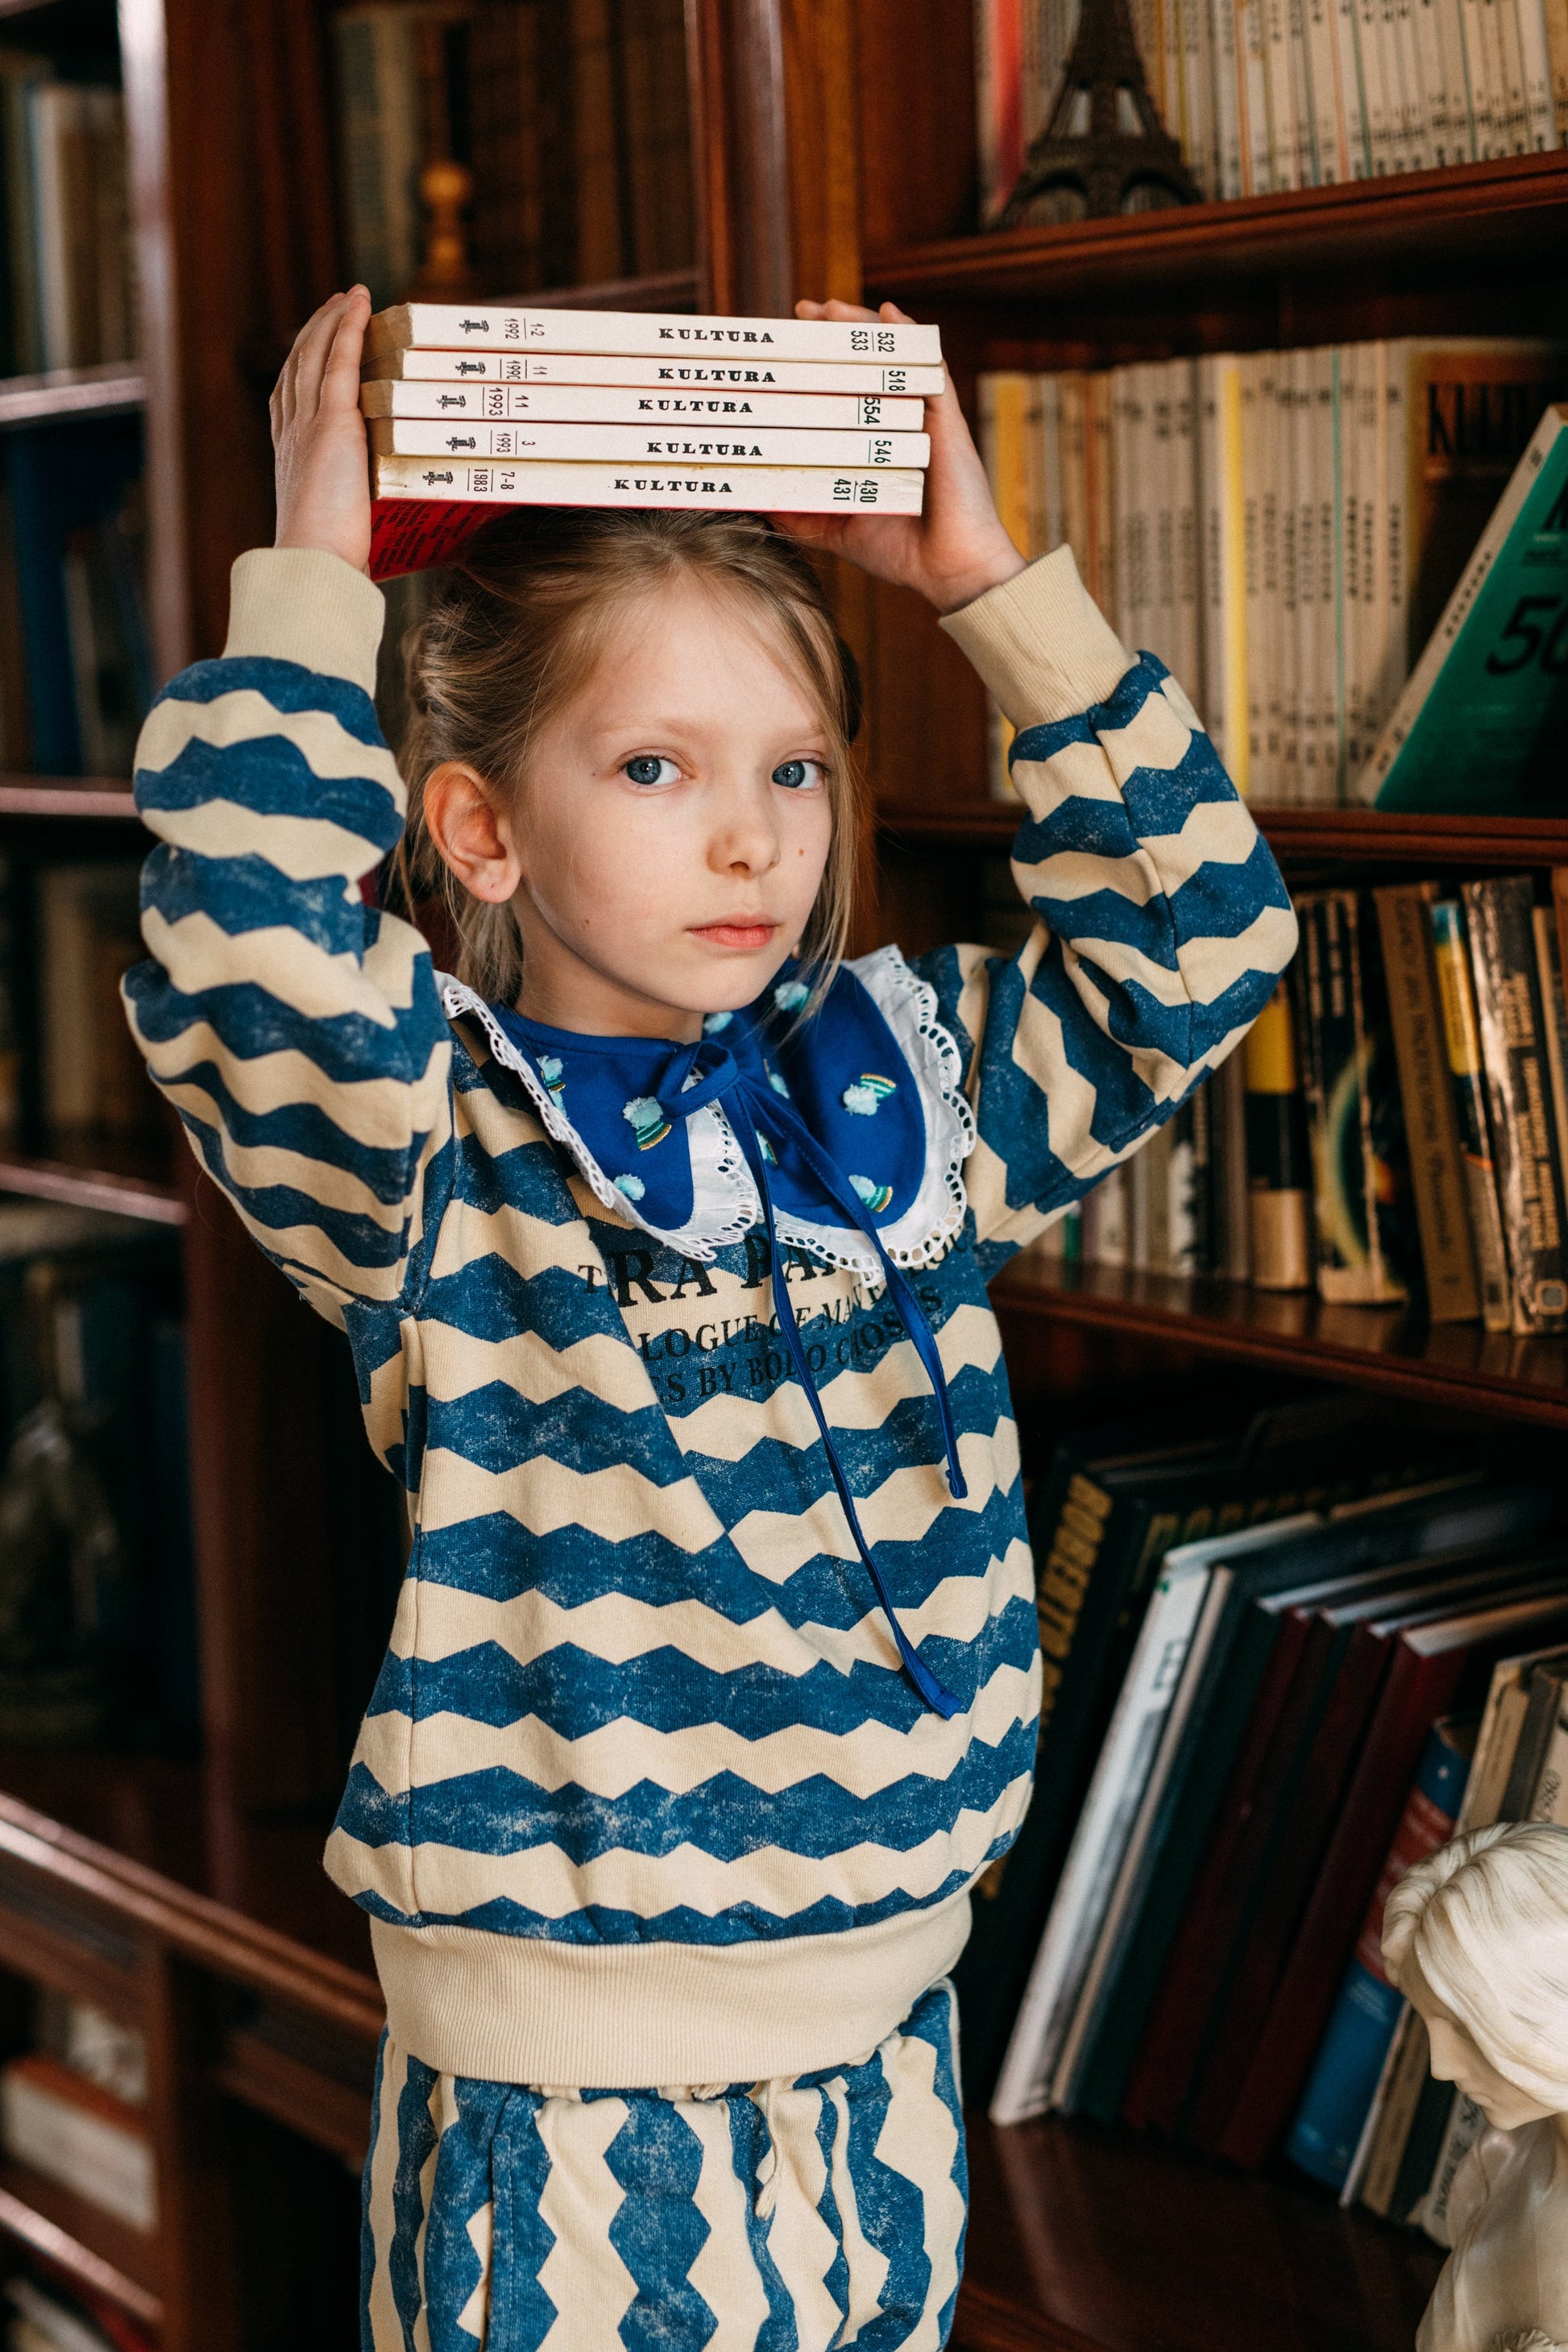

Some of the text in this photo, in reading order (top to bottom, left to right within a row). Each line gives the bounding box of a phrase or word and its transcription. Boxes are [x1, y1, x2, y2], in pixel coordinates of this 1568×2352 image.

[504, 317, 520, 340] 1992
[658, 327, 775, 344] KULTURA
[850, 330, 869, 352] 533
[877, 331, 895, 354] 532
[532, 366, 548, 376] 11
[657, 367, 776, 384] KULTURA
[888, 370, 906, 392] 518
[488, 388, 504, 417] 1993
[515, 395, 529, 409] 11
[637, 399, 753, 413] KULTURA
[863, 396, 881, 425] 554
[496, 432, 512, 454] 1993
[646, 442, 764, 457] KULTURA
[874, 439, 892, 464] 546
[473, 468, 487, 492] 1983
[500, 471, 515, 491] 7-8
[613, 479, 732, 493] KULTURA
[832, 478, 851, 503] 431
[859, 479, 877, 504] 430
[697, 1362, 737, 1397] BY
